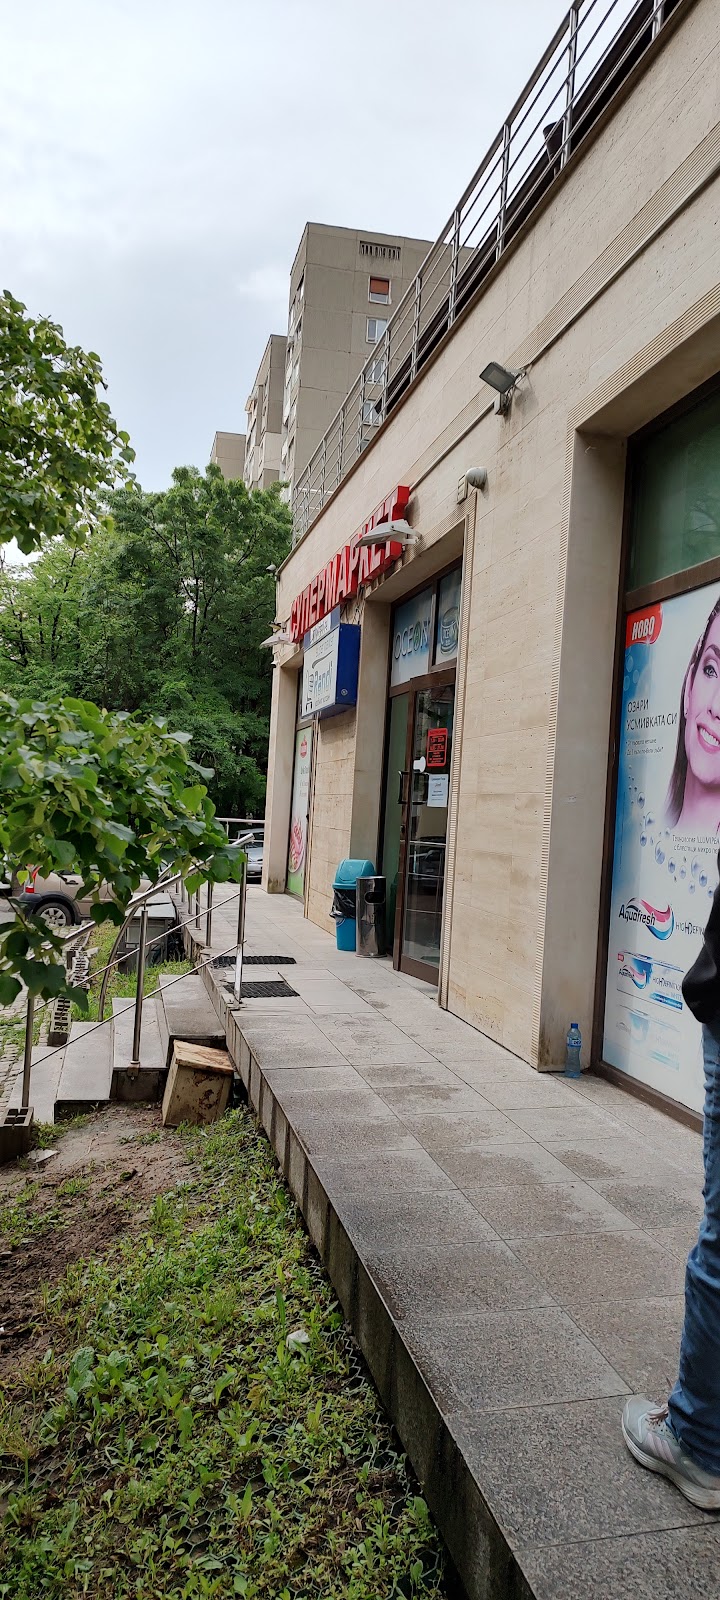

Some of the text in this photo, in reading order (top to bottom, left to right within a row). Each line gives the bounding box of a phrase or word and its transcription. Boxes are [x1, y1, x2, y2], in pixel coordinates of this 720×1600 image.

[289, 486, 405, 643] СУПЕРМАРКЕТ
[631, 616, 656, 641] НОВО
[627, 699, 649, 713] ОЗАРИ
[626, 713, 678, 731] УСМИВКАТА СИ
[618, 904, 656, 926] Aquafresh
